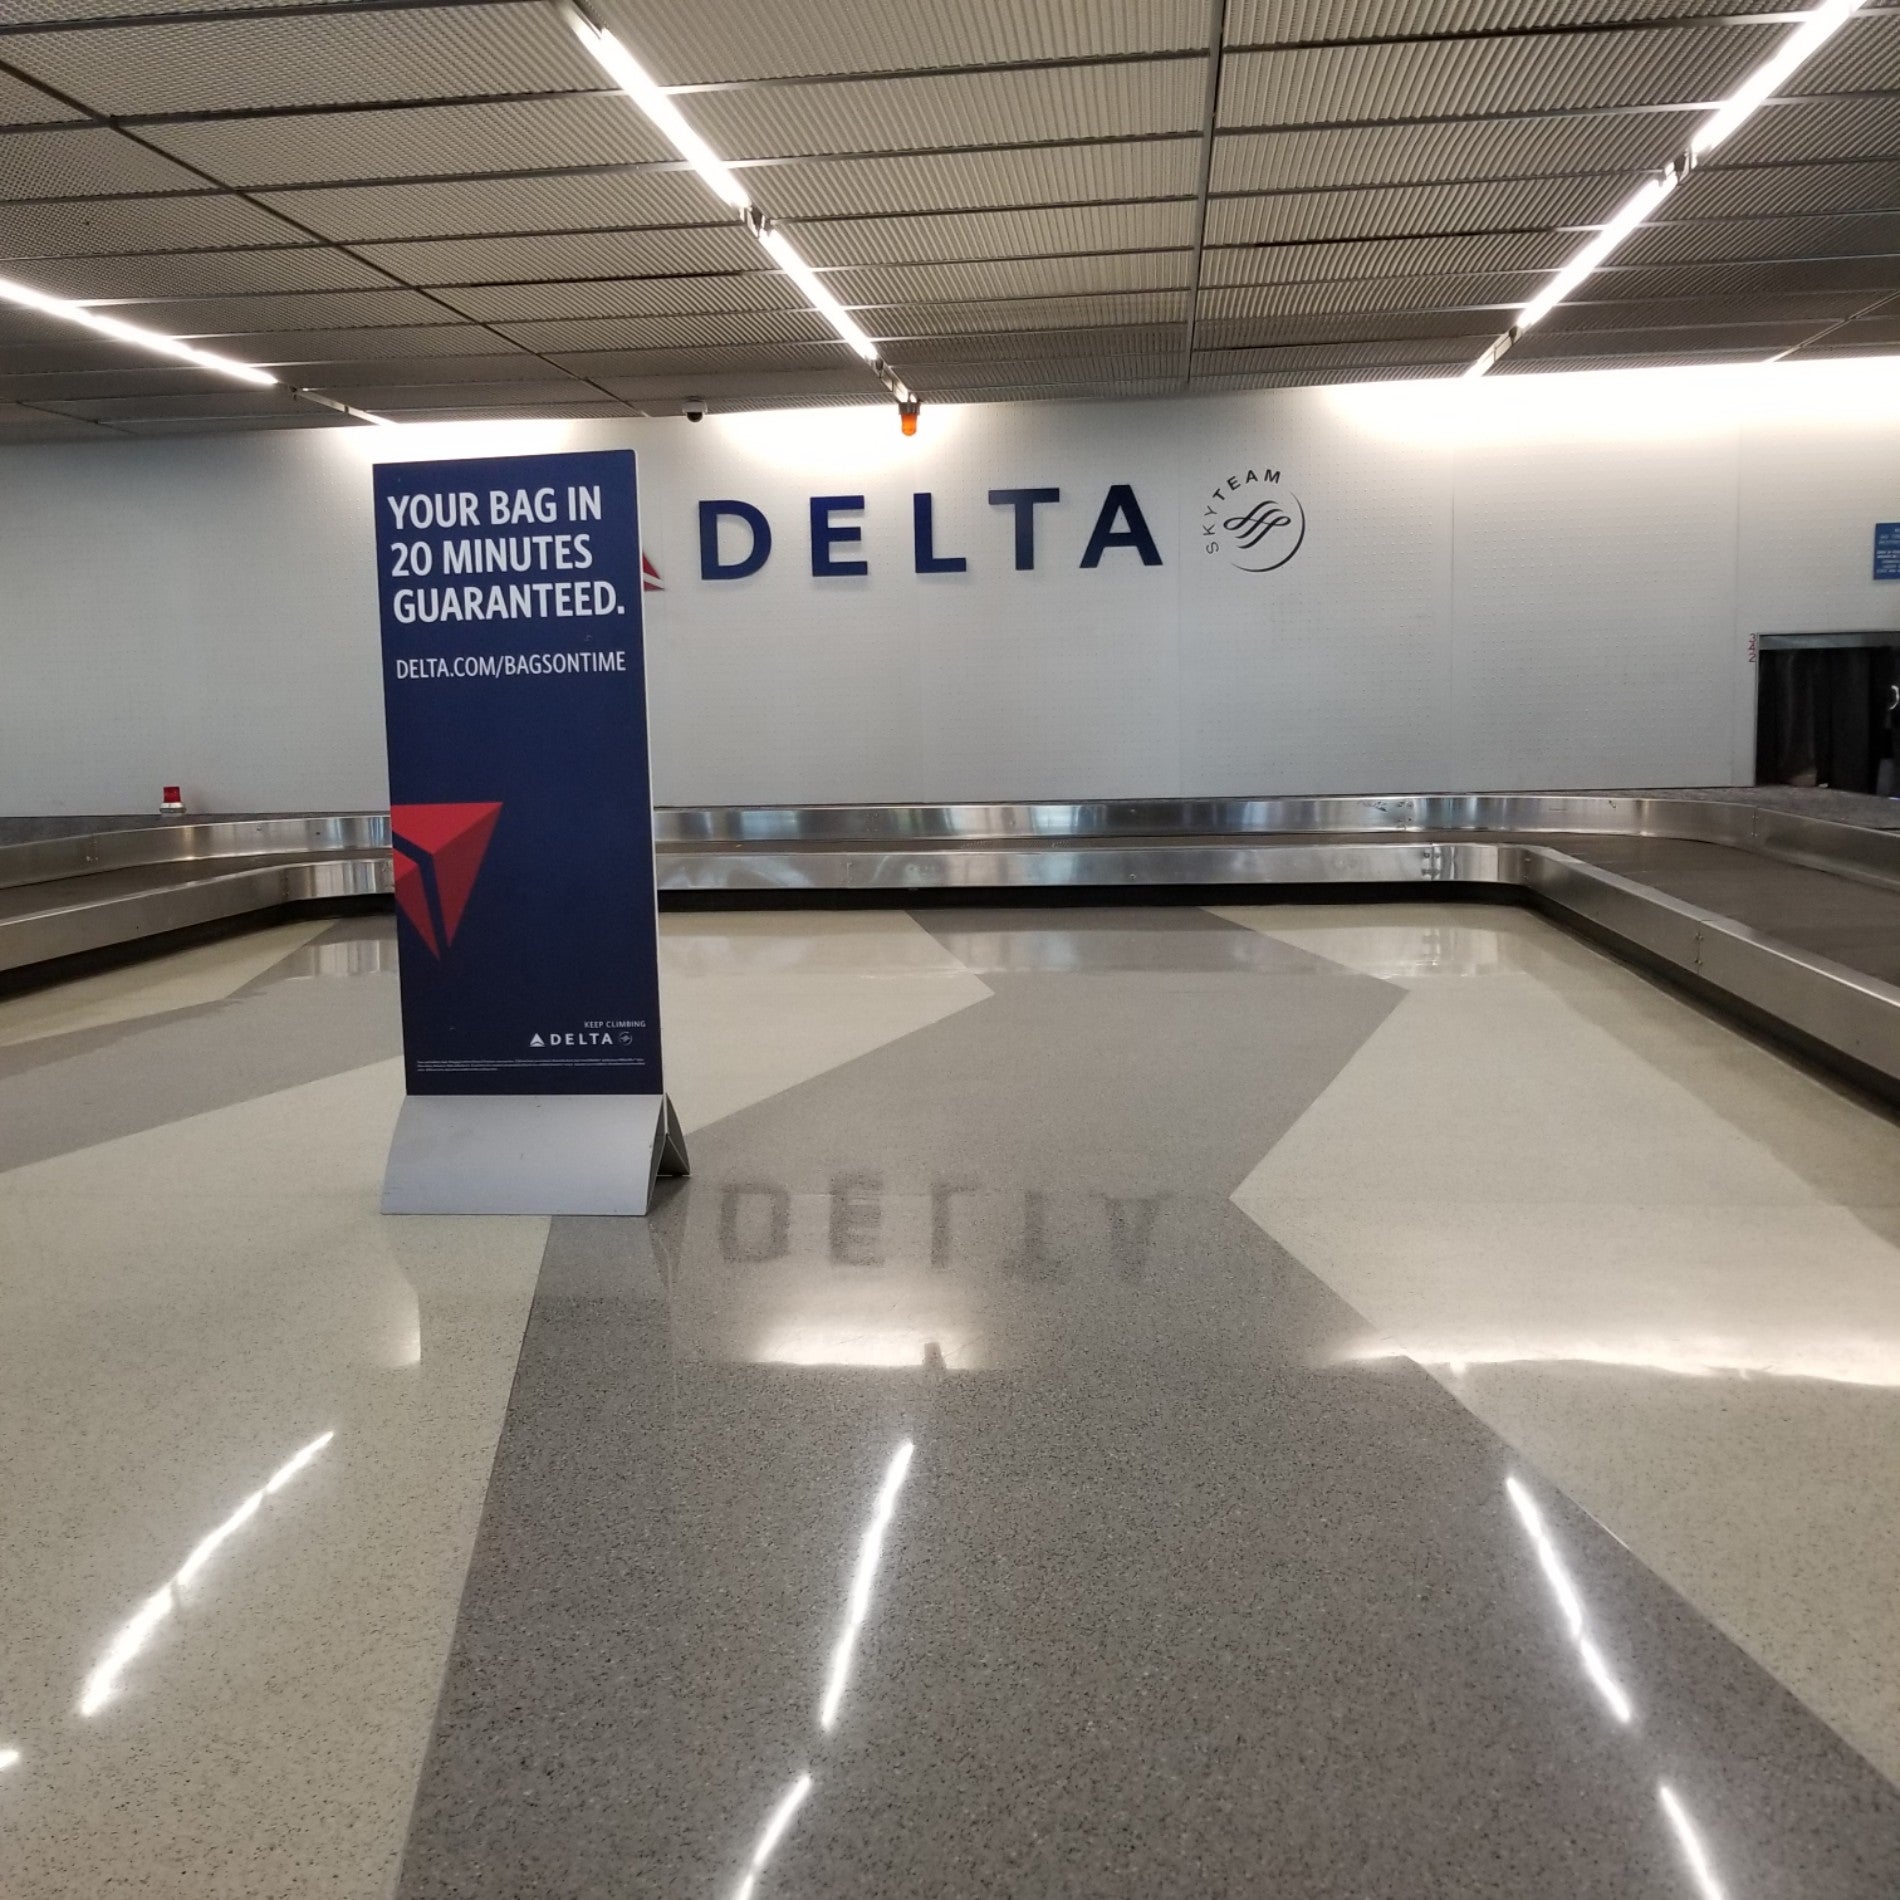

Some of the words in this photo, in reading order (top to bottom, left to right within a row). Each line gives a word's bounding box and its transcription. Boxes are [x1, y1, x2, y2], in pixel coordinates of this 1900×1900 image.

[387, 492, 480, 529] YOUR
[490, 488, 557, 525] BAG
[568, 485, 602, 521] IN
[1202, 469, 1281, 554] SKYTEAM
[698, 484, 1163, 580] DELTA
[391, 541, 433, 577] 20
[443, 534, 593, 574] MINUTES
[393, 581, 625, 624] GUARANTEED.
[396, 651, 626, 679] DELTA.COM/BAGSONTIME
[550, 1032, 614, 1046] DELTA
[584, 1020, 603, 1029] KEEP
[606, 1020, 646, 1028] CLIMBING
